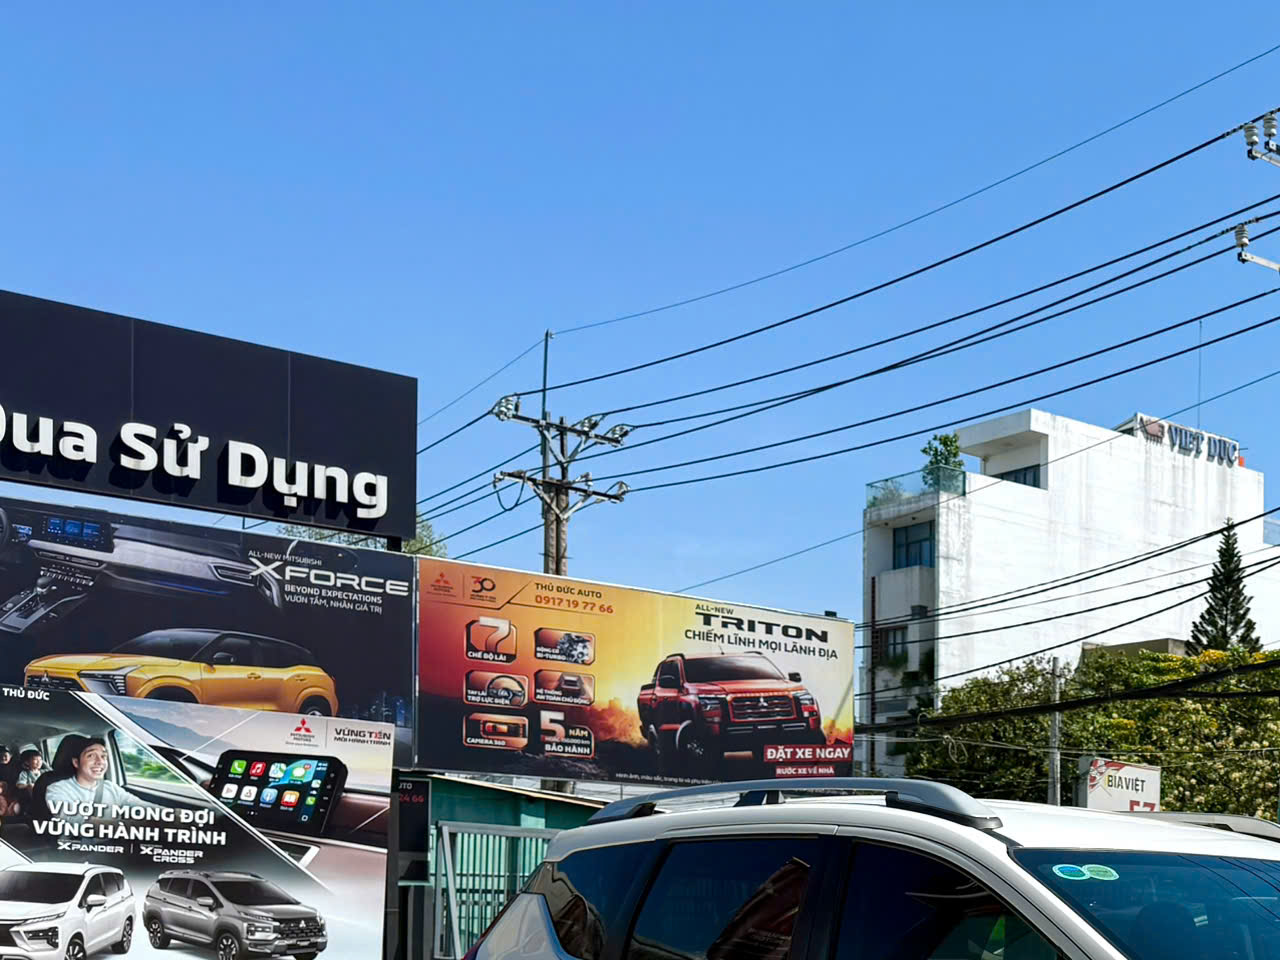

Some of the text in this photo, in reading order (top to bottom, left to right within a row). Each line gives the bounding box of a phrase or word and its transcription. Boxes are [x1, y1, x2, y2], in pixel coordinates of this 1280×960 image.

[120, 421, 209, 479] Sử
[228, 440, 388, 519] Dụng
[248, 550, 322, 566] ALL-NEW MITSUBISHI
[249, 557, 409, 596] XFORCE
[285, 584, 382, 604] BEYOND EXPECTATIONS
[535, 594, 614, 614] 0917 19 77 66
[577, 589, 602, 599] AUTO
[695, 603, 734, 615] ALL-NEW
[480, 615, 511, 654] 7
[695, 612, 828, 643] TRITON
[684, 628, 838, 661] CHIẾM LĨNH MỌI LÃNH ĐỊA
[540, 710, 565, 740] 5
[545, 742, 590, 754] BẢO HÀNH
[767, 745, 850, 763] ĐẶT XE NGAY
[798, 767, 807, 775] XE
[49, 800, 214, 827] VƯỢT MONG ĐỢI
[33, 818, 226, 845] VỮNG HÀNH TRÌNH
[57, 841, 203, 858] XPANDER XPANDER
[153, 855, 195, 864] CROSS
